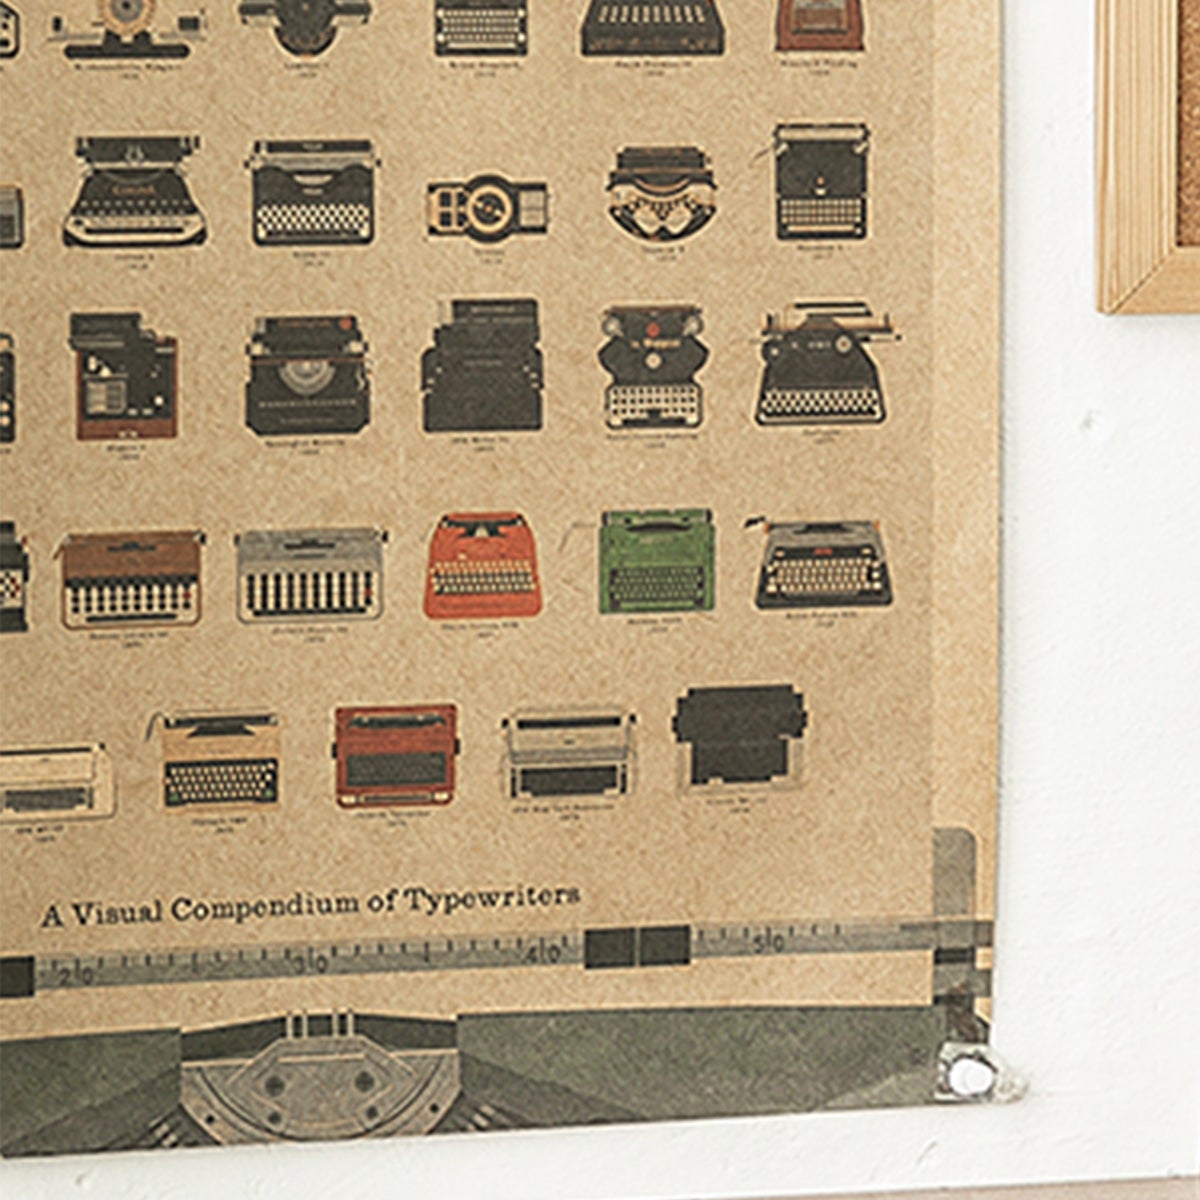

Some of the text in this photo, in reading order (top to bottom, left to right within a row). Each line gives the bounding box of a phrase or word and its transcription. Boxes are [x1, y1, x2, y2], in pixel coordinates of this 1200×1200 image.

[41, 884, 581, 928] A Visual Compendium of Typewriters
